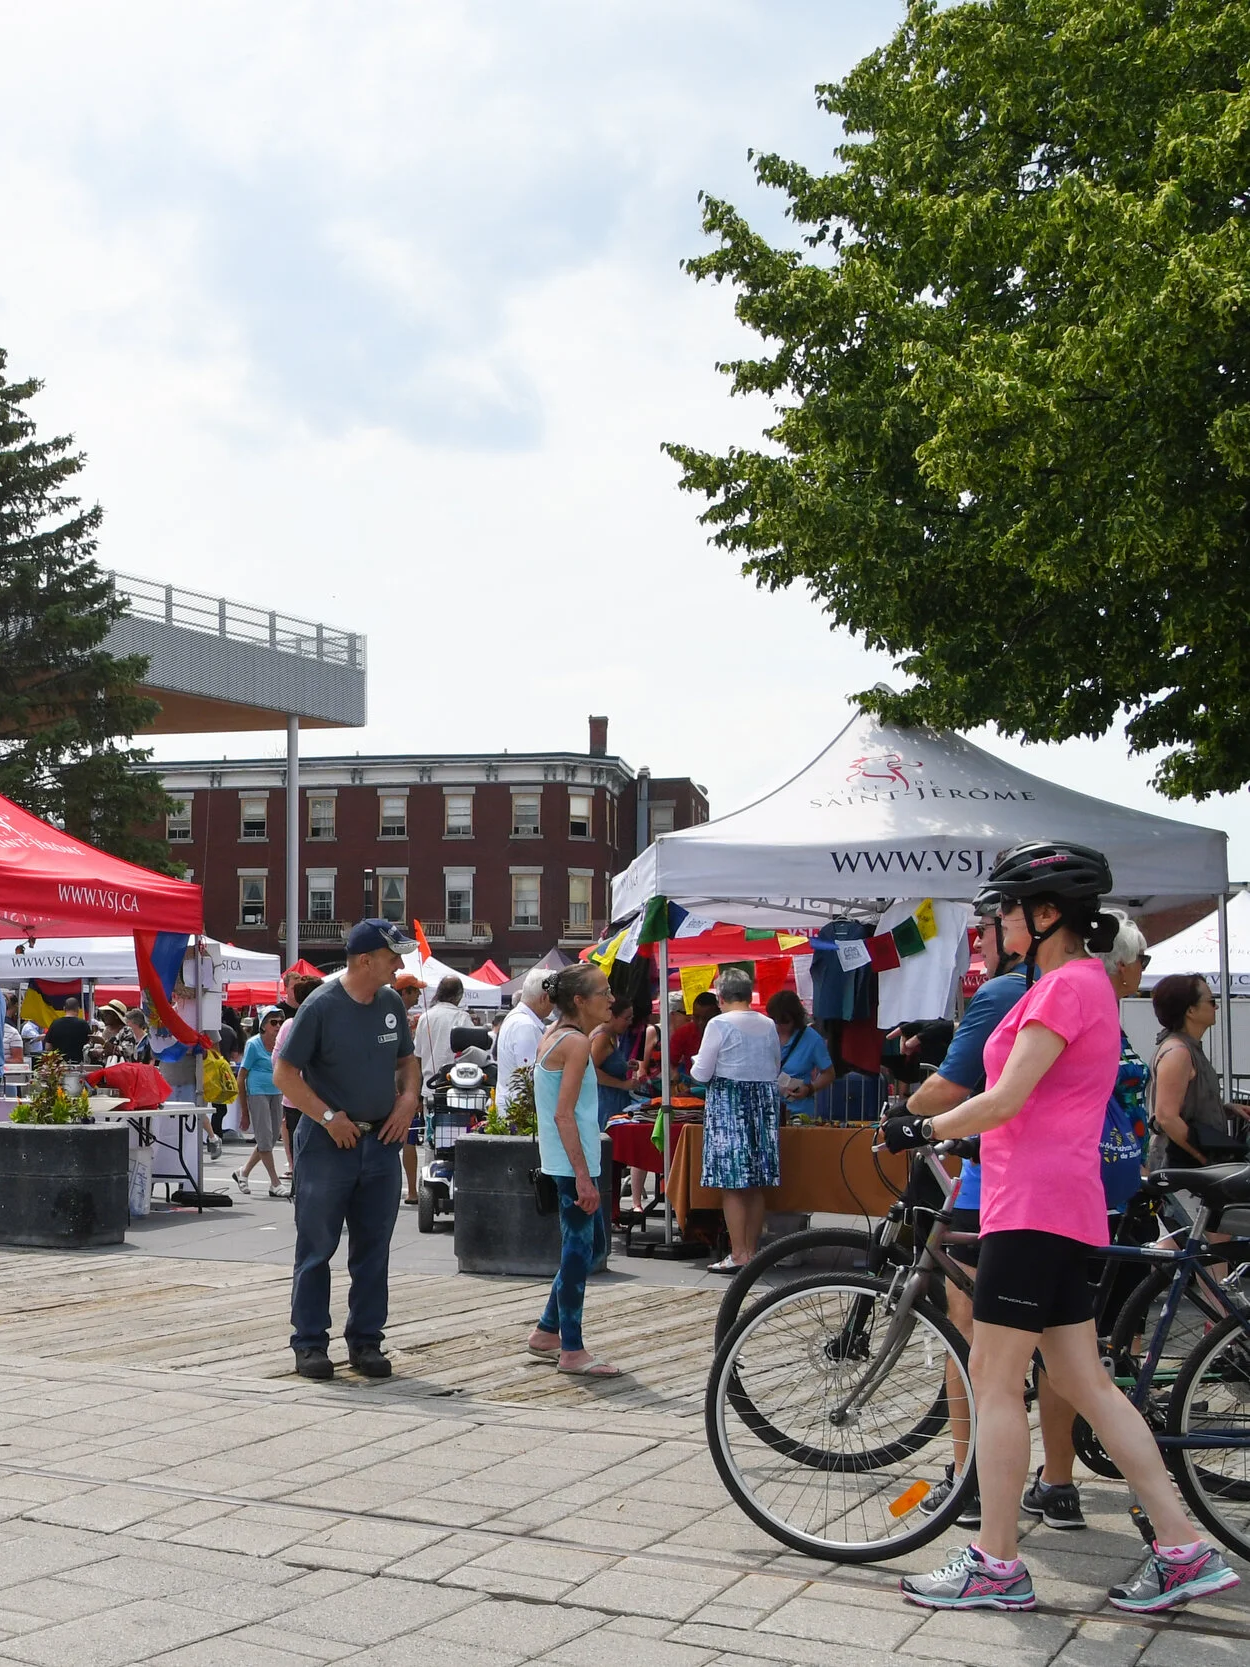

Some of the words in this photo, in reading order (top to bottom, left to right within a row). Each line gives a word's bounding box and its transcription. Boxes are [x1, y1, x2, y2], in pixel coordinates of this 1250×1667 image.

[810, 787, 1037, 809] SAINT-JÉRÔME
[57, 883, 140, 915] WWW.VSJ.CA
[11, 955, 85, 970] WWW.VSJ.CA
